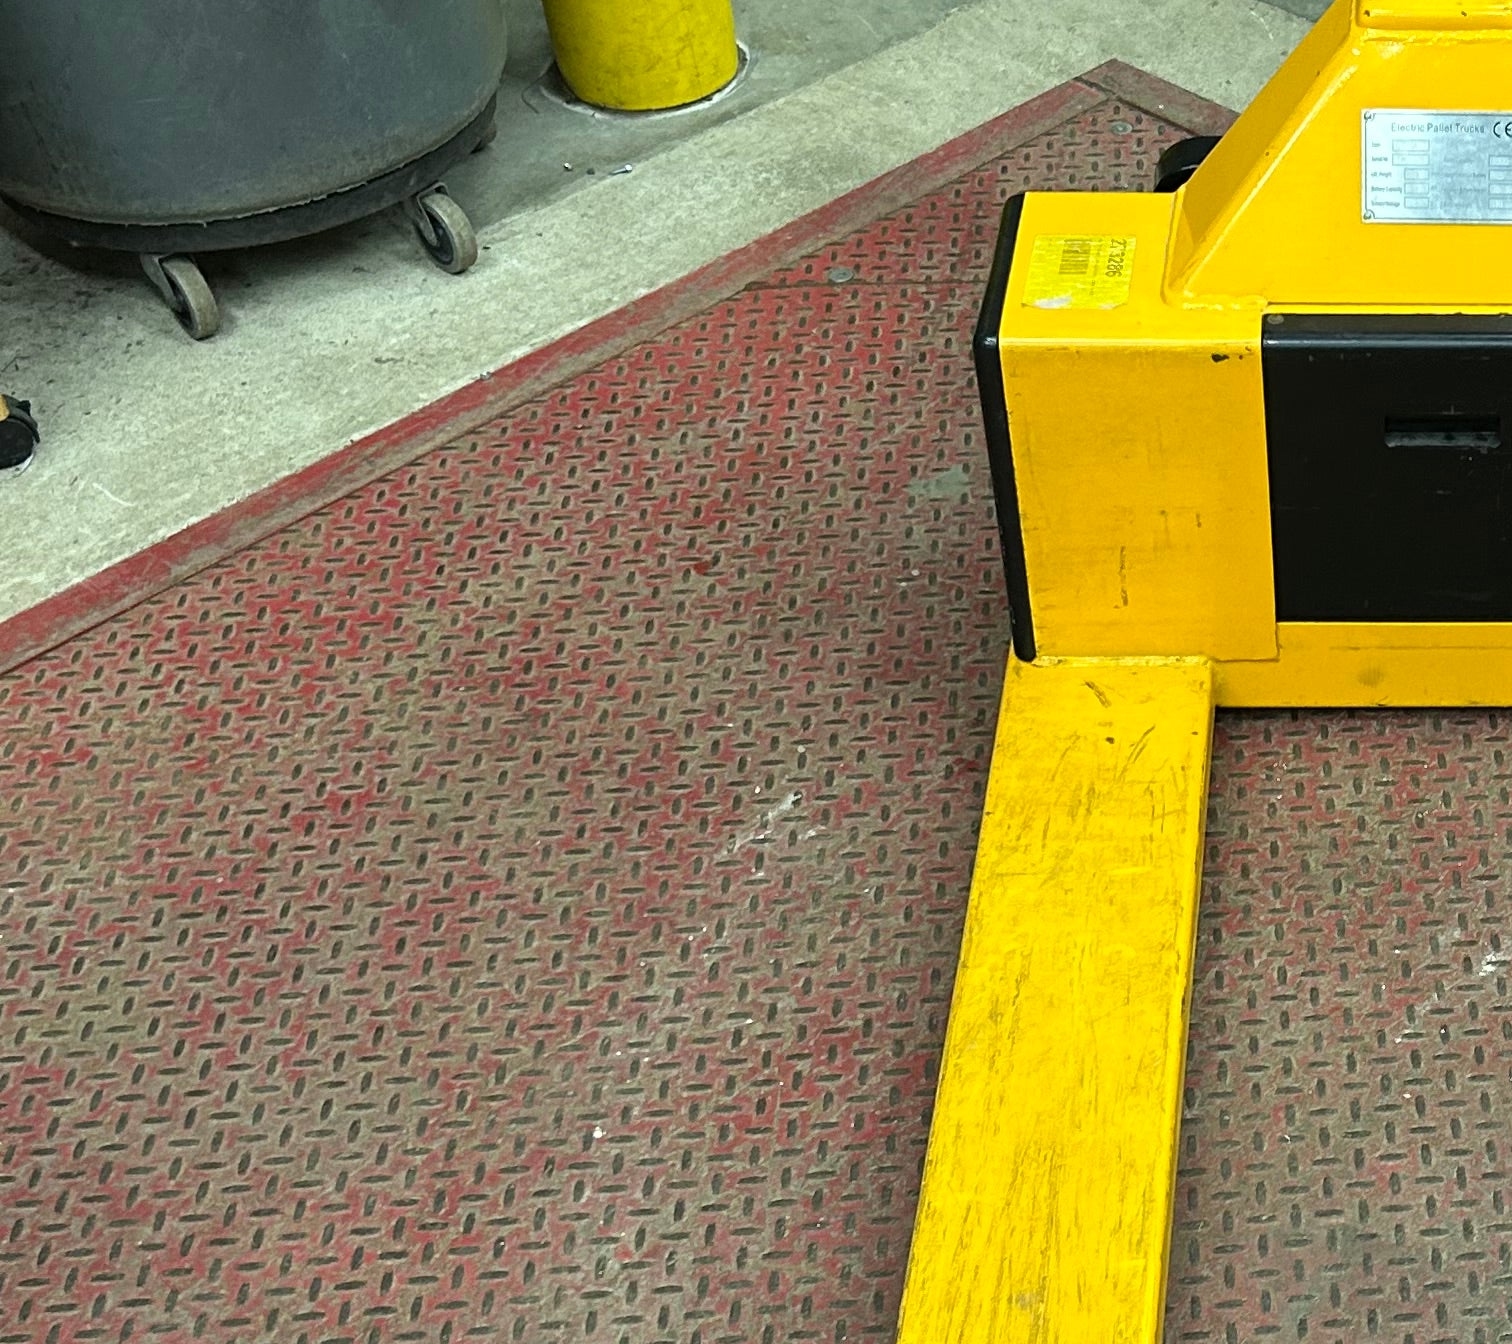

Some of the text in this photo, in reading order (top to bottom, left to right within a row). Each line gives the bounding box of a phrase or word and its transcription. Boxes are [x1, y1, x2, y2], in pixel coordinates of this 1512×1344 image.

[1391, 122, 1425, 133] Electric
[1426, 122, 1453, 133] Pallet
[1455, 122, 1485, 134] Trucks
